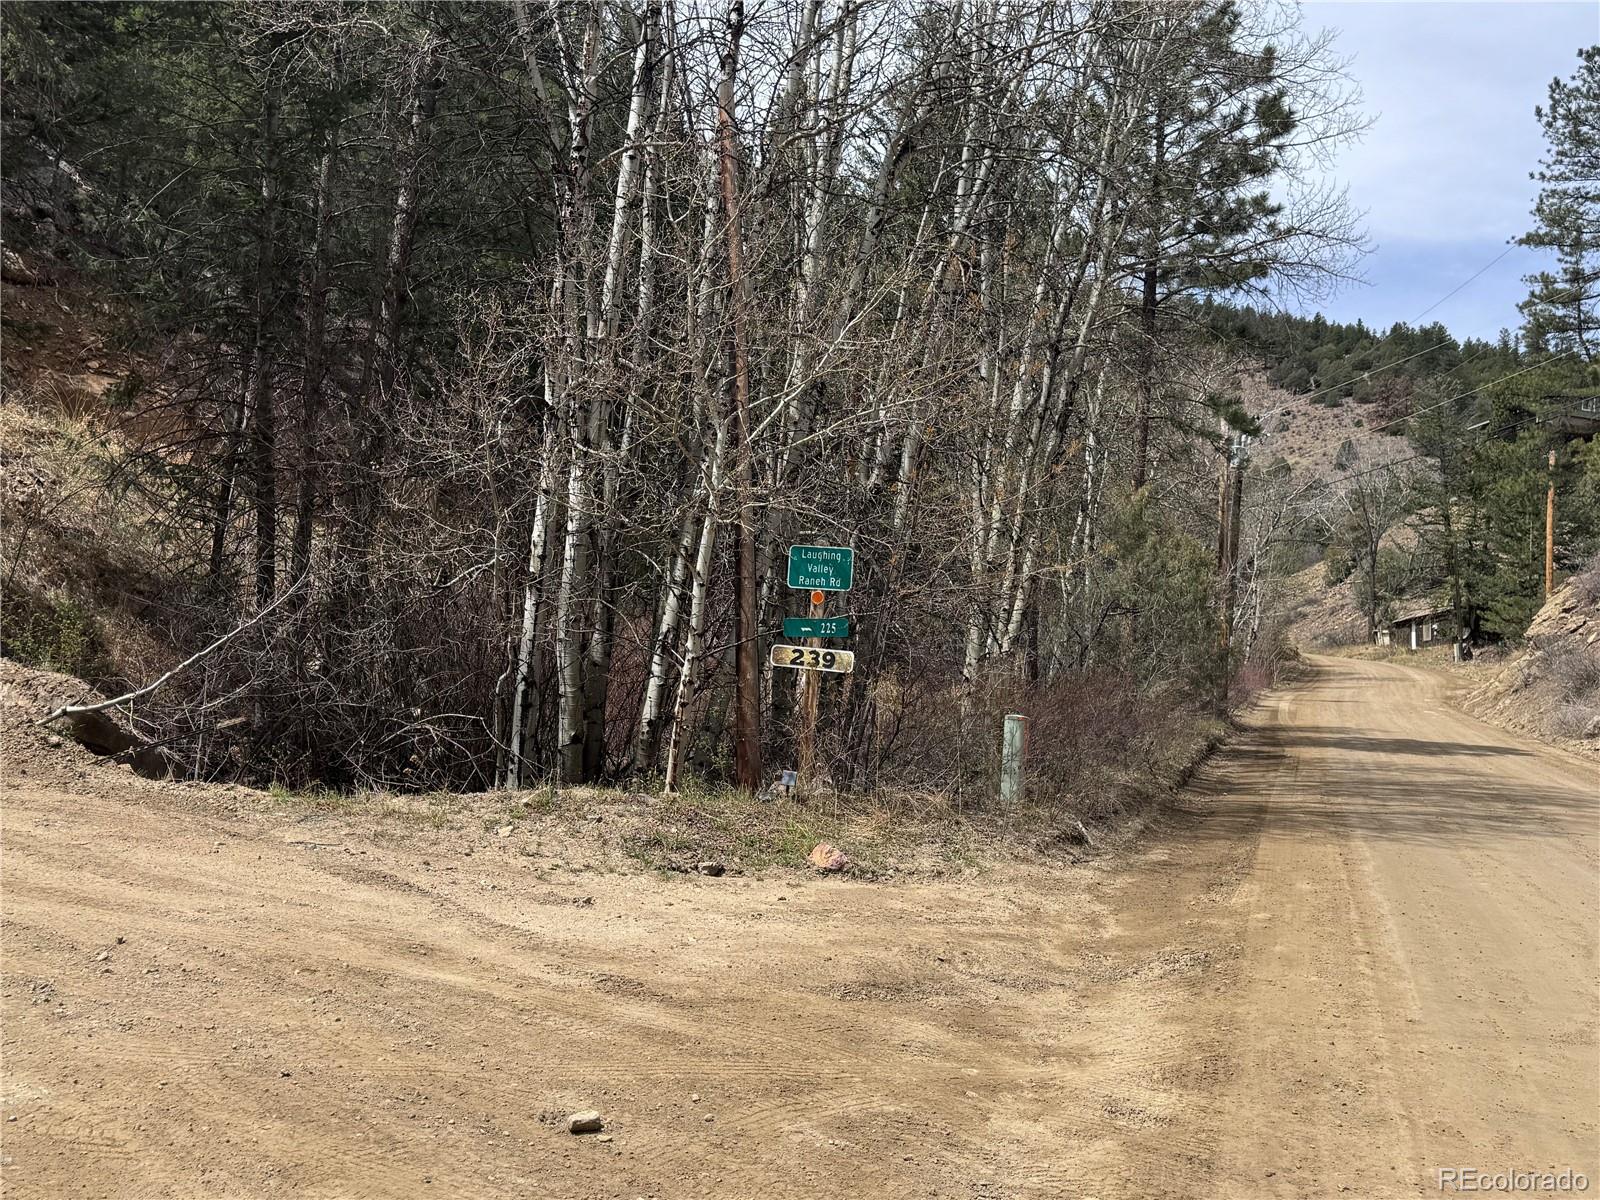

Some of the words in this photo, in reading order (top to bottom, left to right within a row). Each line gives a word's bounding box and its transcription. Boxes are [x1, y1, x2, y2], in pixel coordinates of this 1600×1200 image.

[801, 549, 841, 563] Laughing
[807, 563, 834, 576] Valley
[829, 577, 841, 587] Rd
[820, 622, 837, 634] 225
[790, 648, 836, 669] 239
